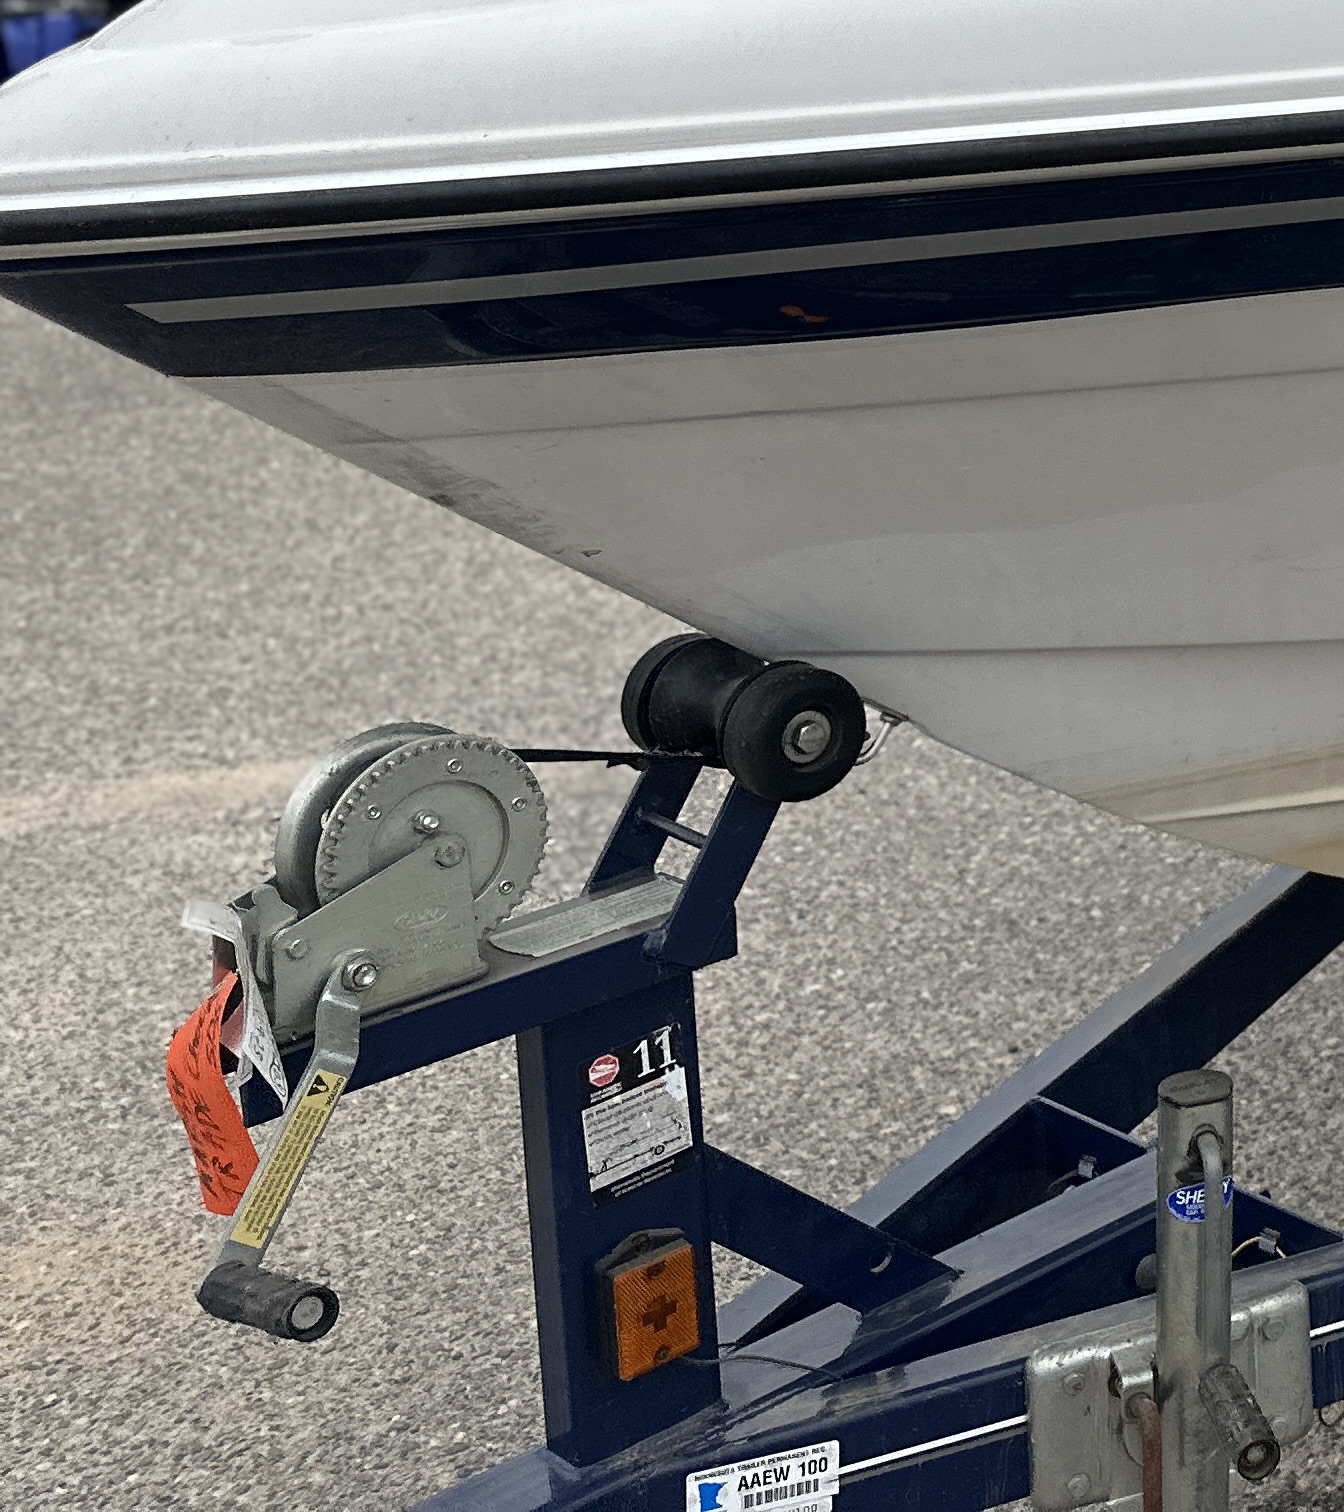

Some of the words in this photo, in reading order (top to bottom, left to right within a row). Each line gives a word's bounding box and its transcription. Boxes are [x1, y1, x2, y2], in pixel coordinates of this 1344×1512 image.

[632, 1029, 677, 1079] 11
[738, 1467, 791, 1492] AAEW
[798, 1457, 828, 1477] 100
